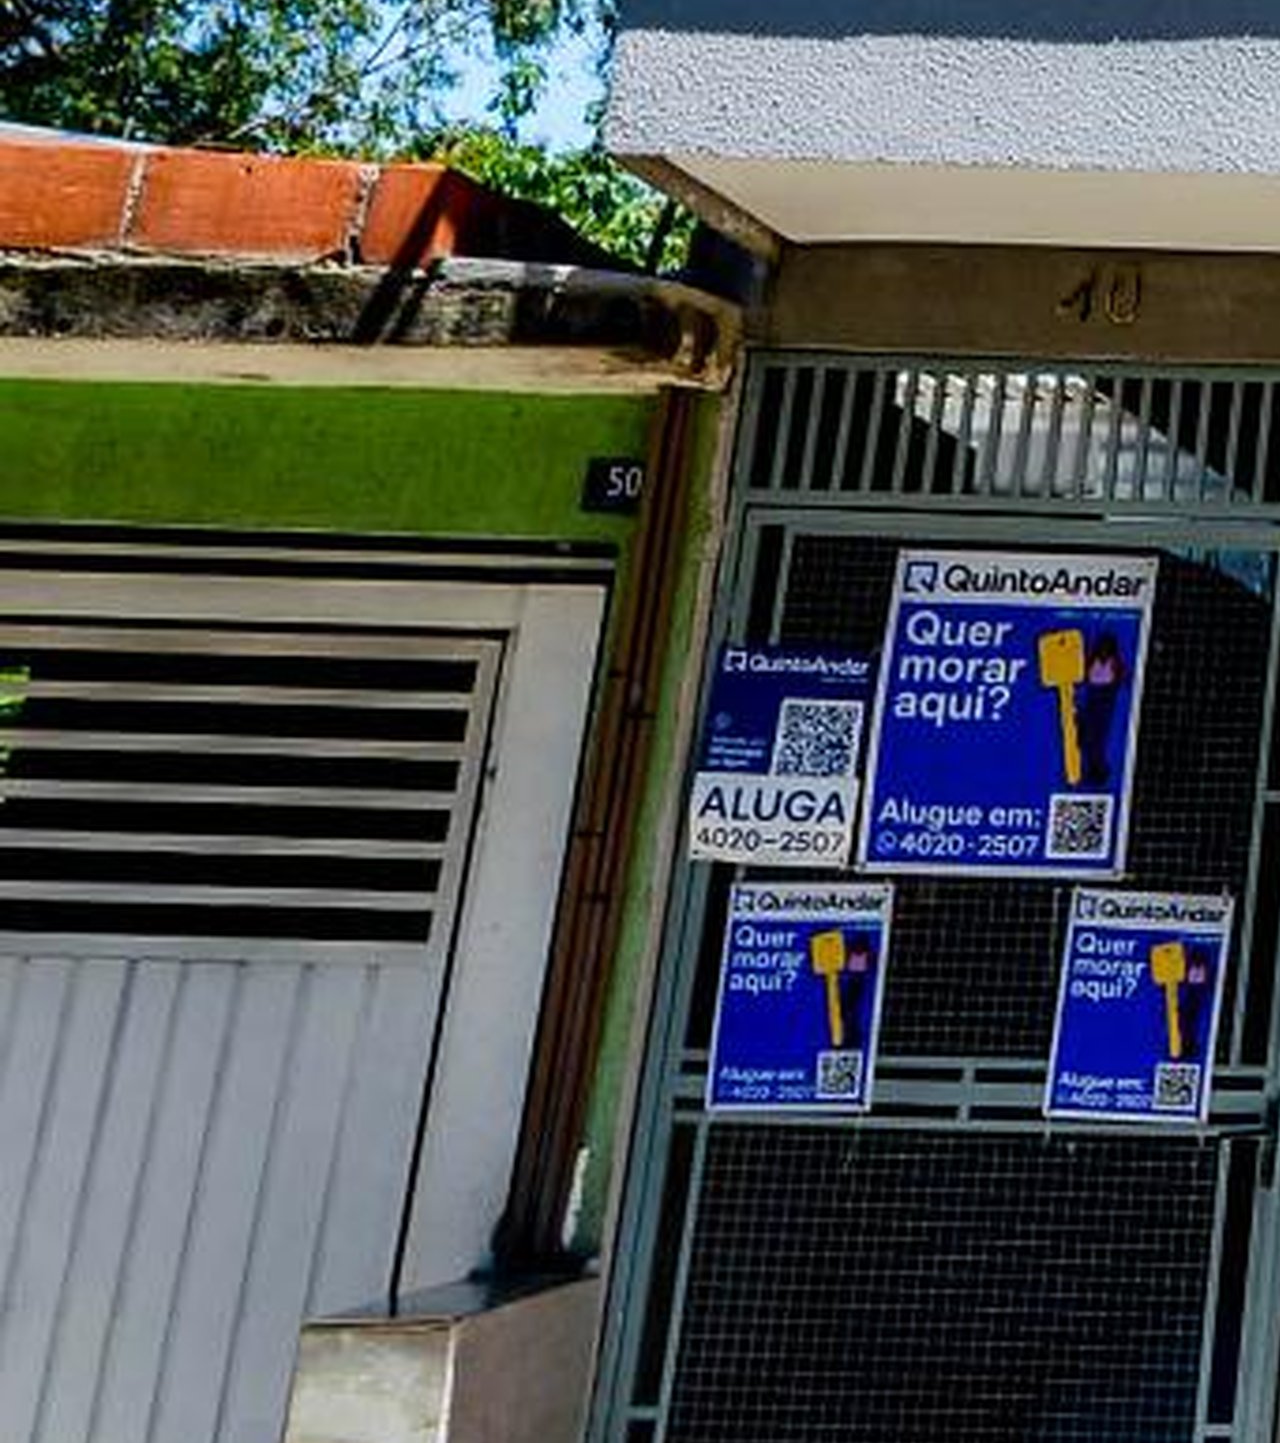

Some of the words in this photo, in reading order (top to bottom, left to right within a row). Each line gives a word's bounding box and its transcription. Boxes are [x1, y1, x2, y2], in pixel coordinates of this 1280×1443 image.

[607, 466, 642, 498] 50
[943, 564, 1148, 597] QuintoAndar
[905, 610, 1013, 646] Quer
[750, 654, 870, 675] QuintoAndar
[899, 654, 1027, 684] morar
[894, 685, 1010, 728] aqui?
[698, 786, 845, 824] ALUGA
[877, 797, 983, 832] Alugue
[988, 806, 1042, 829] em:
[697, 827, 845, 854] 4020-2507
[735, 925, 798, 948] Quer
[1076, 933, 1138, 956] Quer
[731, 951, 806, 969] morar
[1073, 958, 1147, 978] morar
[729, 969, 798, 996] aqui?
[1070, 980, 1137, 1002] aqui?
